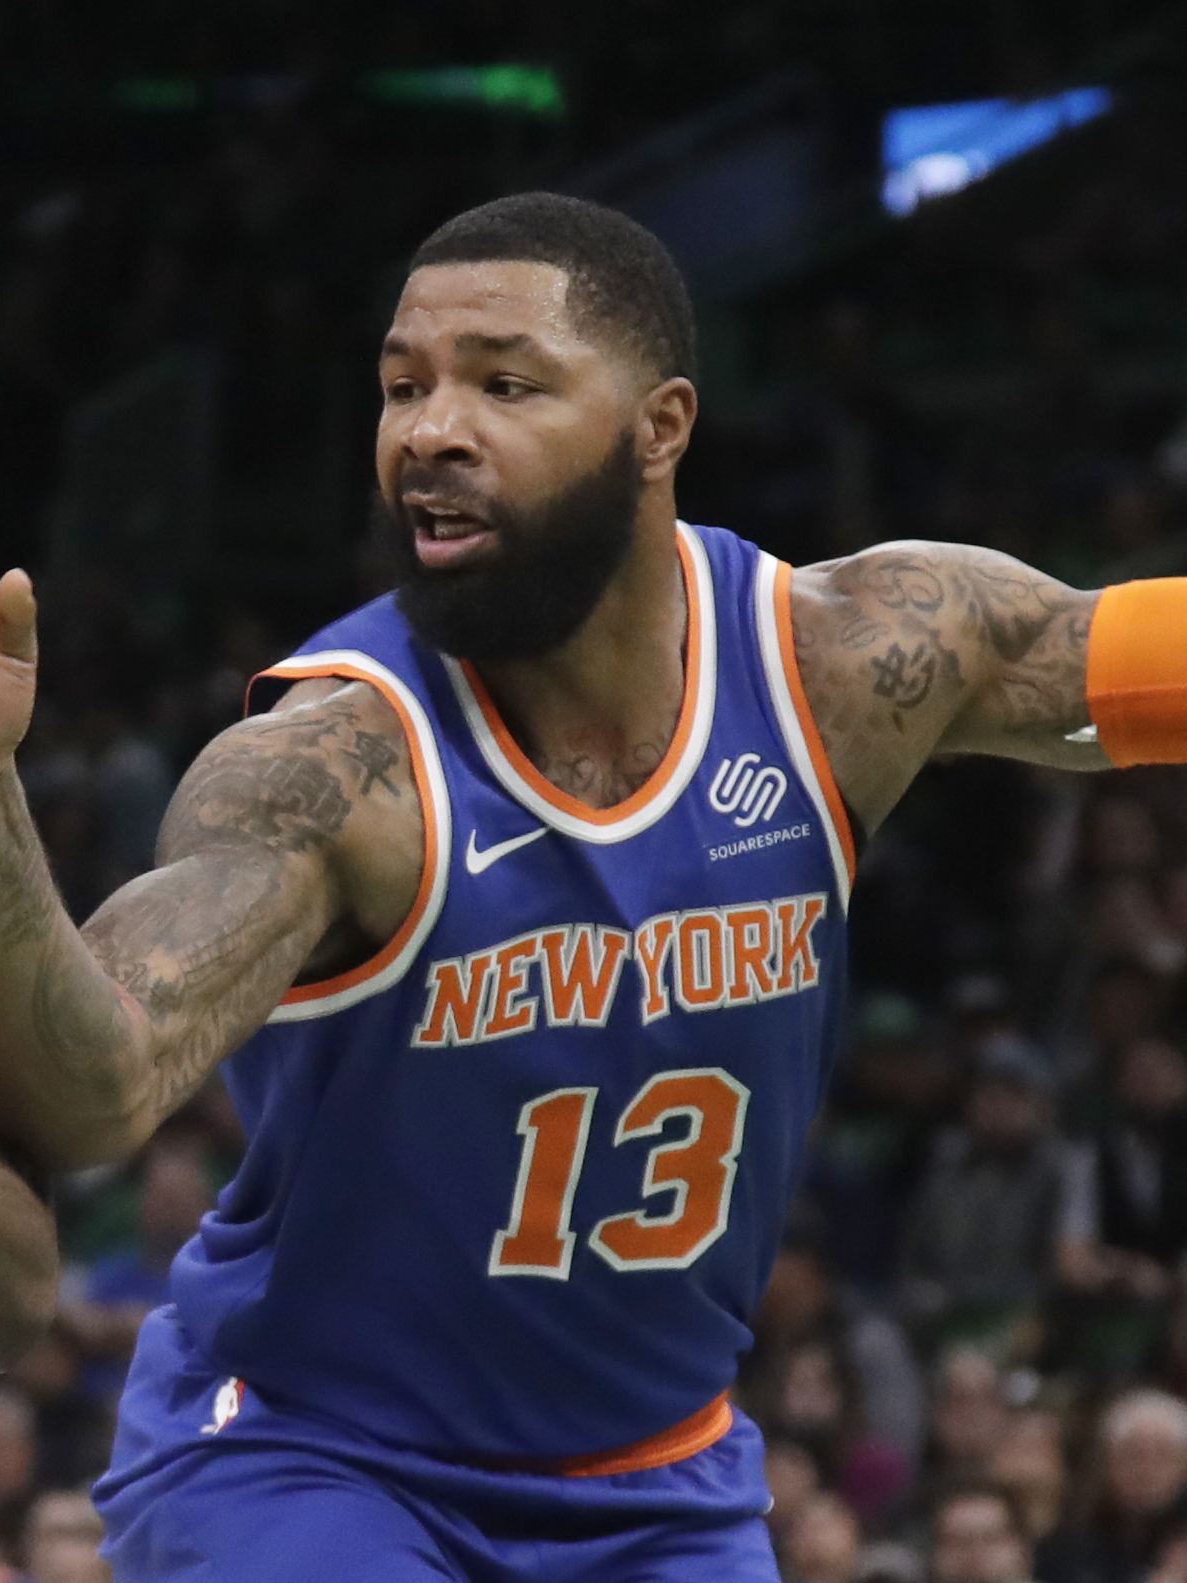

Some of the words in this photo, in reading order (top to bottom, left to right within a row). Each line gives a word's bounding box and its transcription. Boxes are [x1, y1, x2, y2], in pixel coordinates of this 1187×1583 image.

[709, 823, 811, 862] SQUARESPACE
[410, 922, 633, 1048] NEW
[633, 891, 829, 1026] YORK
[488, 1066, 752, 1281] 13
